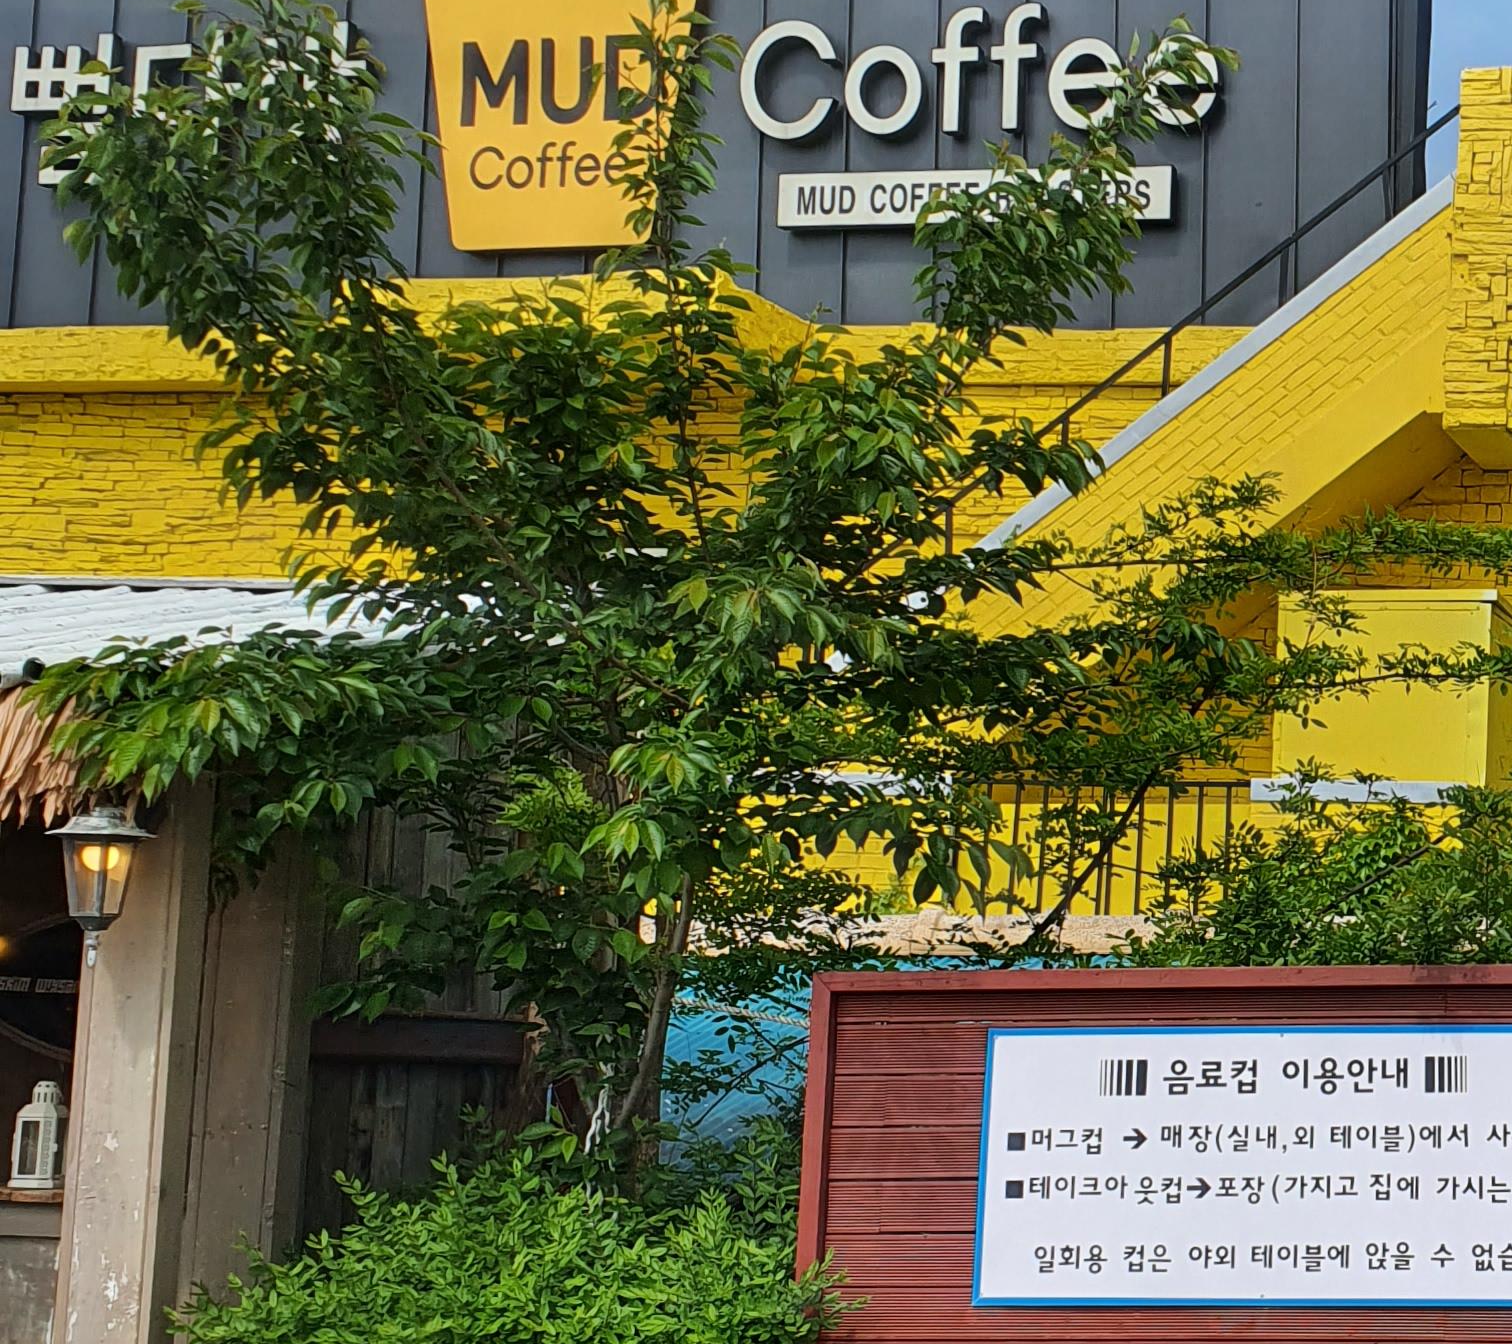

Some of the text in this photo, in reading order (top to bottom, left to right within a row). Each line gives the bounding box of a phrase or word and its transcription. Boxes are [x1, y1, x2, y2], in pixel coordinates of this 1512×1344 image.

[460, 33, 664, 127] MUD
[739, 1, 1221, 140] Coffee
[469, 140, 636, 190] Coffee
[796, 185, 857, 216] MUD
[869, 182, 980, 214] COF
[1163, 1057, 1409, 1096] 음료컵 이용안내
[1031, 1127, 1103, 1155] 머그컵
[1330, 1123, 1469, 1154] 테이블)에서
[1369, 1173, 1420, 1201] 집에
[1436, 1175, 1511, 1204] 가시는
[1034, 1244, 1107, 1274] 일회용
[1123, 1244, 1172, 1273] 컵은
[1188, 1244, 1236, 1270] 야외
[1251, 1243, 1351, 1272] 테이블에
[1365, 1241, 1415, 1271] 앉을
[1430, 1243, 1455, 1269] 수
